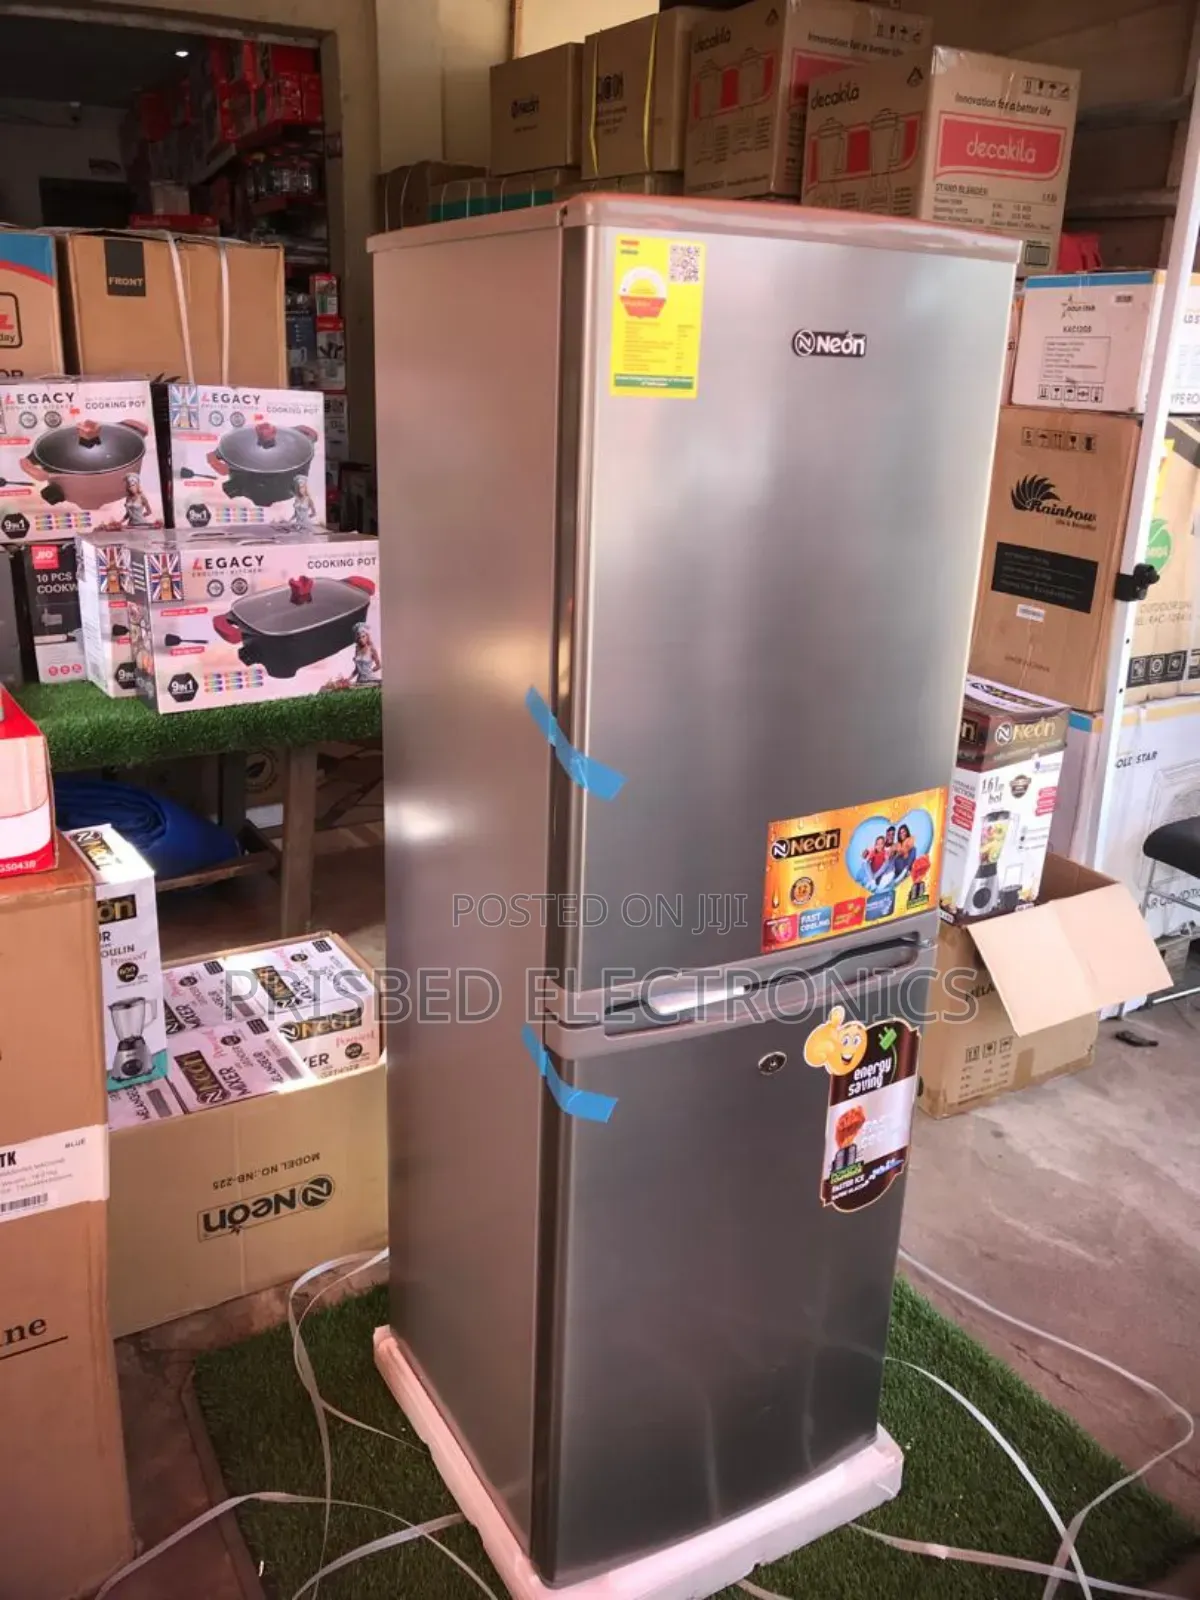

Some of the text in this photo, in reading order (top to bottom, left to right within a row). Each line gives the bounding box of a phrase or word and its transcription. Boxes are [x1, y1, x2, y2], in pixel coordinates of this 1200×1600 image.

[108, 276, 143, 287] FRONT
[4, 391, 75, 405] LEGACY
[85, 400, 146, 410] COOKING POT
[202, 392, 261, 405] LEGACY
[192, 555, 265, 571] LEGACY
[307, 556, 377, 570] COOKING POT
[36, 571, 73, 583] 10 PCS
[801, 912, 821, 923] FAST
[853, 1056, 892, 1081] energy
[848, 1073, 884, 1097] saving
[280, 1152, 321, 1171] MODEL
[4, 1318, 47, 1346] ne
